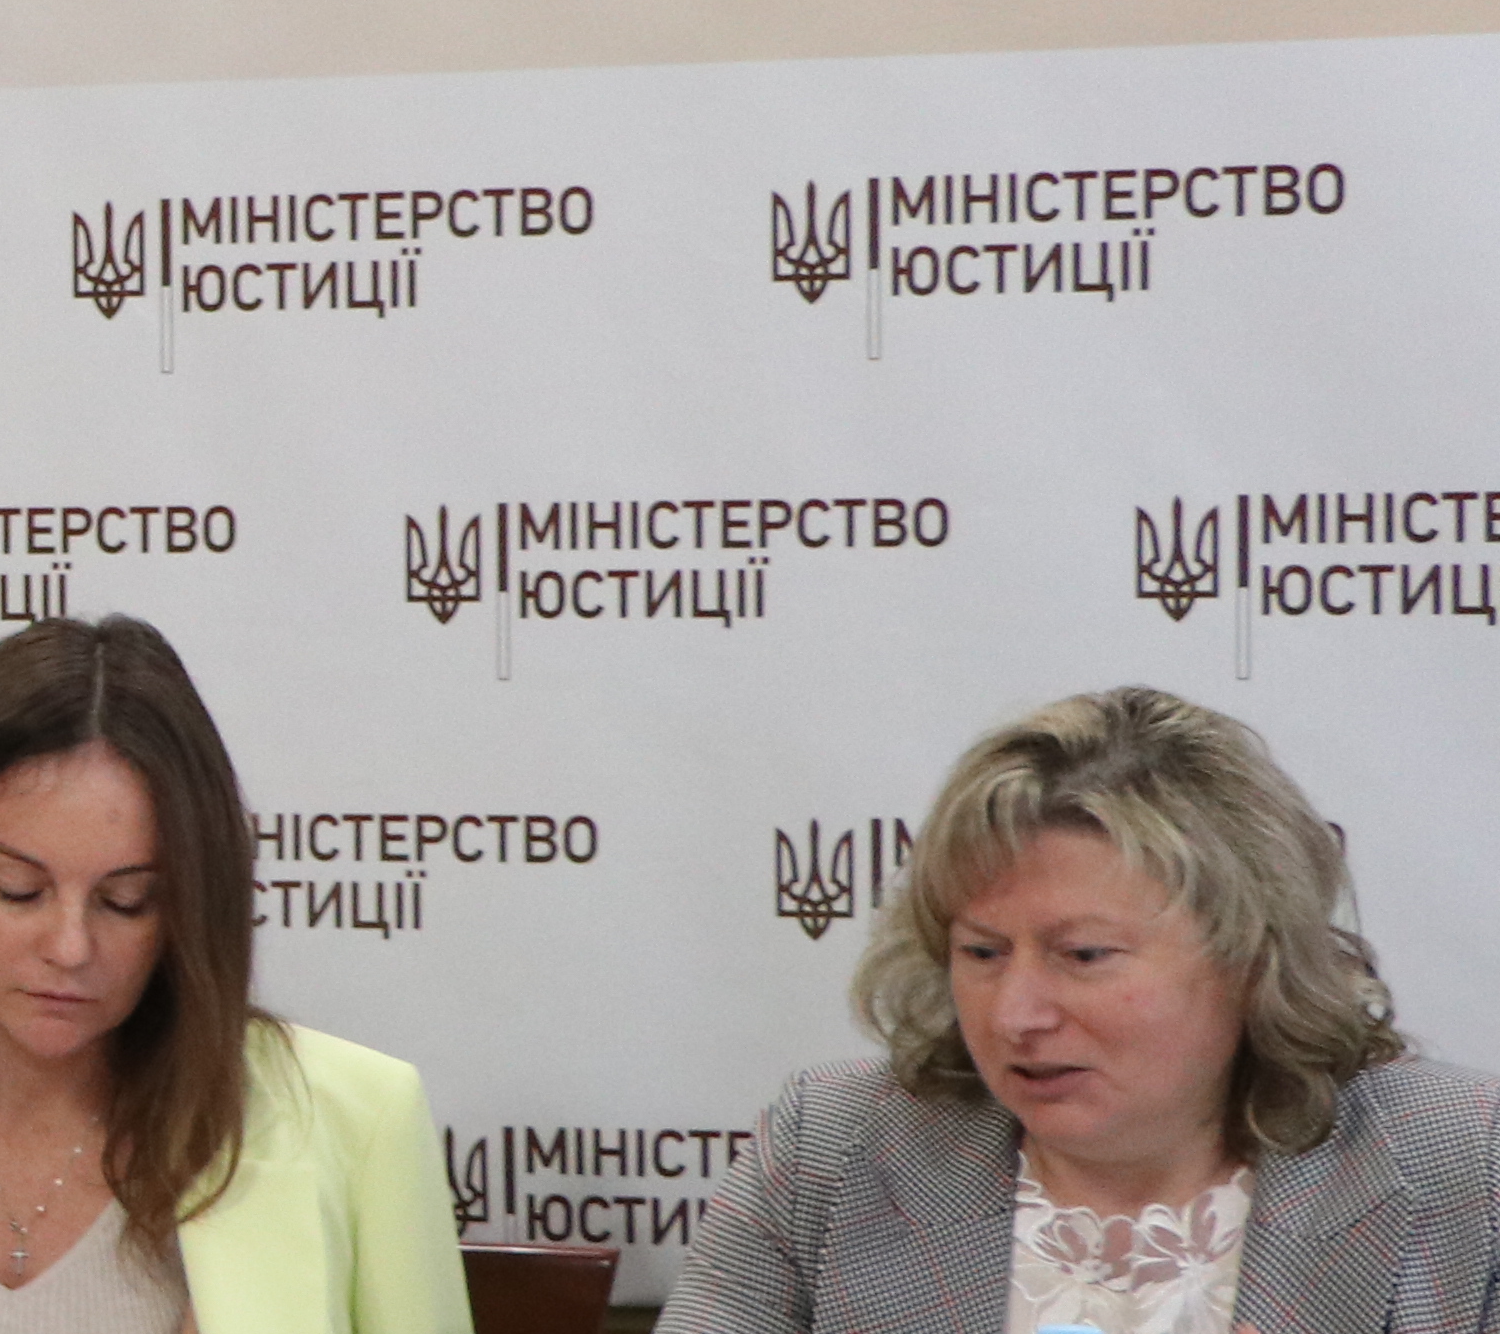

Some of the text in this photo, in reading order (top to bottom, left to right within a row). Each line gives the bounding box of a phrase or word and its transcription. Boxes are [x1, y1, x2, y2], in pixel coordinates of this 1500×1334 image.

[180, 188, 594, 247] МІНІСТЕРСТВО
[893, 164, 1344, 227] МІНІСТЕРСТВО
[181, 248, 418, 319] ЮСТИЦІЇ
[892, 230, 1153, 303] ЮСТИЦІЇ
[518, 498, 951, 554] МІНІСТЕРСТВО
[519, 559, 768, 629] ЮСТИЦІЇ
[251, 813, 598, 863] НІСТЕРСТВО
